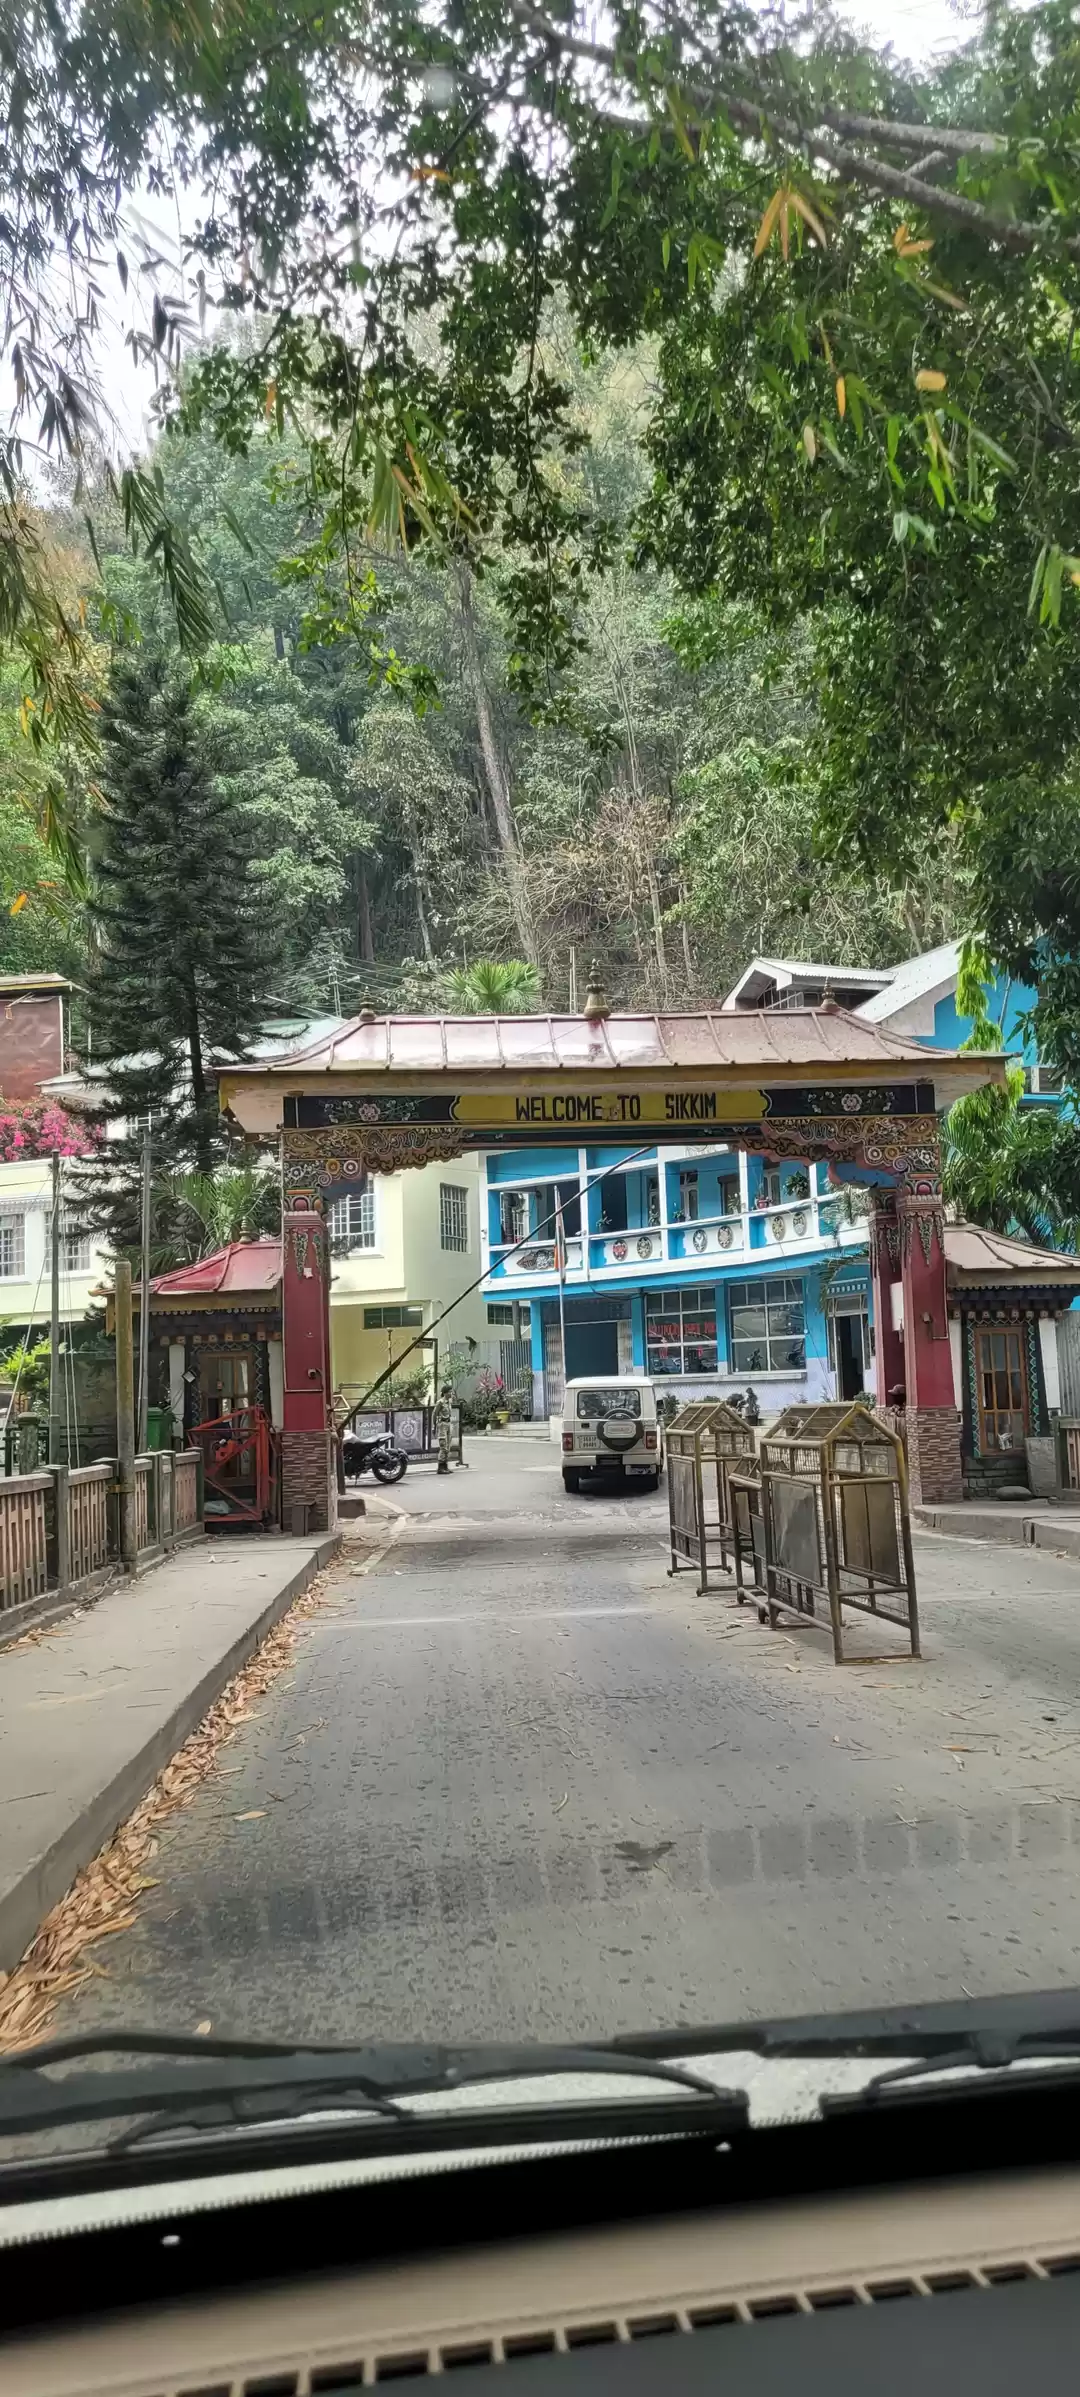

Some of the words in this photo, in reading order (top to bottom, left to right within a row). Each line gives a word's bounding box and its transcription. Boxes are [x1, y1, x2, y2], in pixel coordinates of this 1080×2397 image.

[515, 1095, 603, 1121] WELCOME
[617, 1094, 641, 1120] TO
[665, 1092, 717, 1120] SIKKIM
